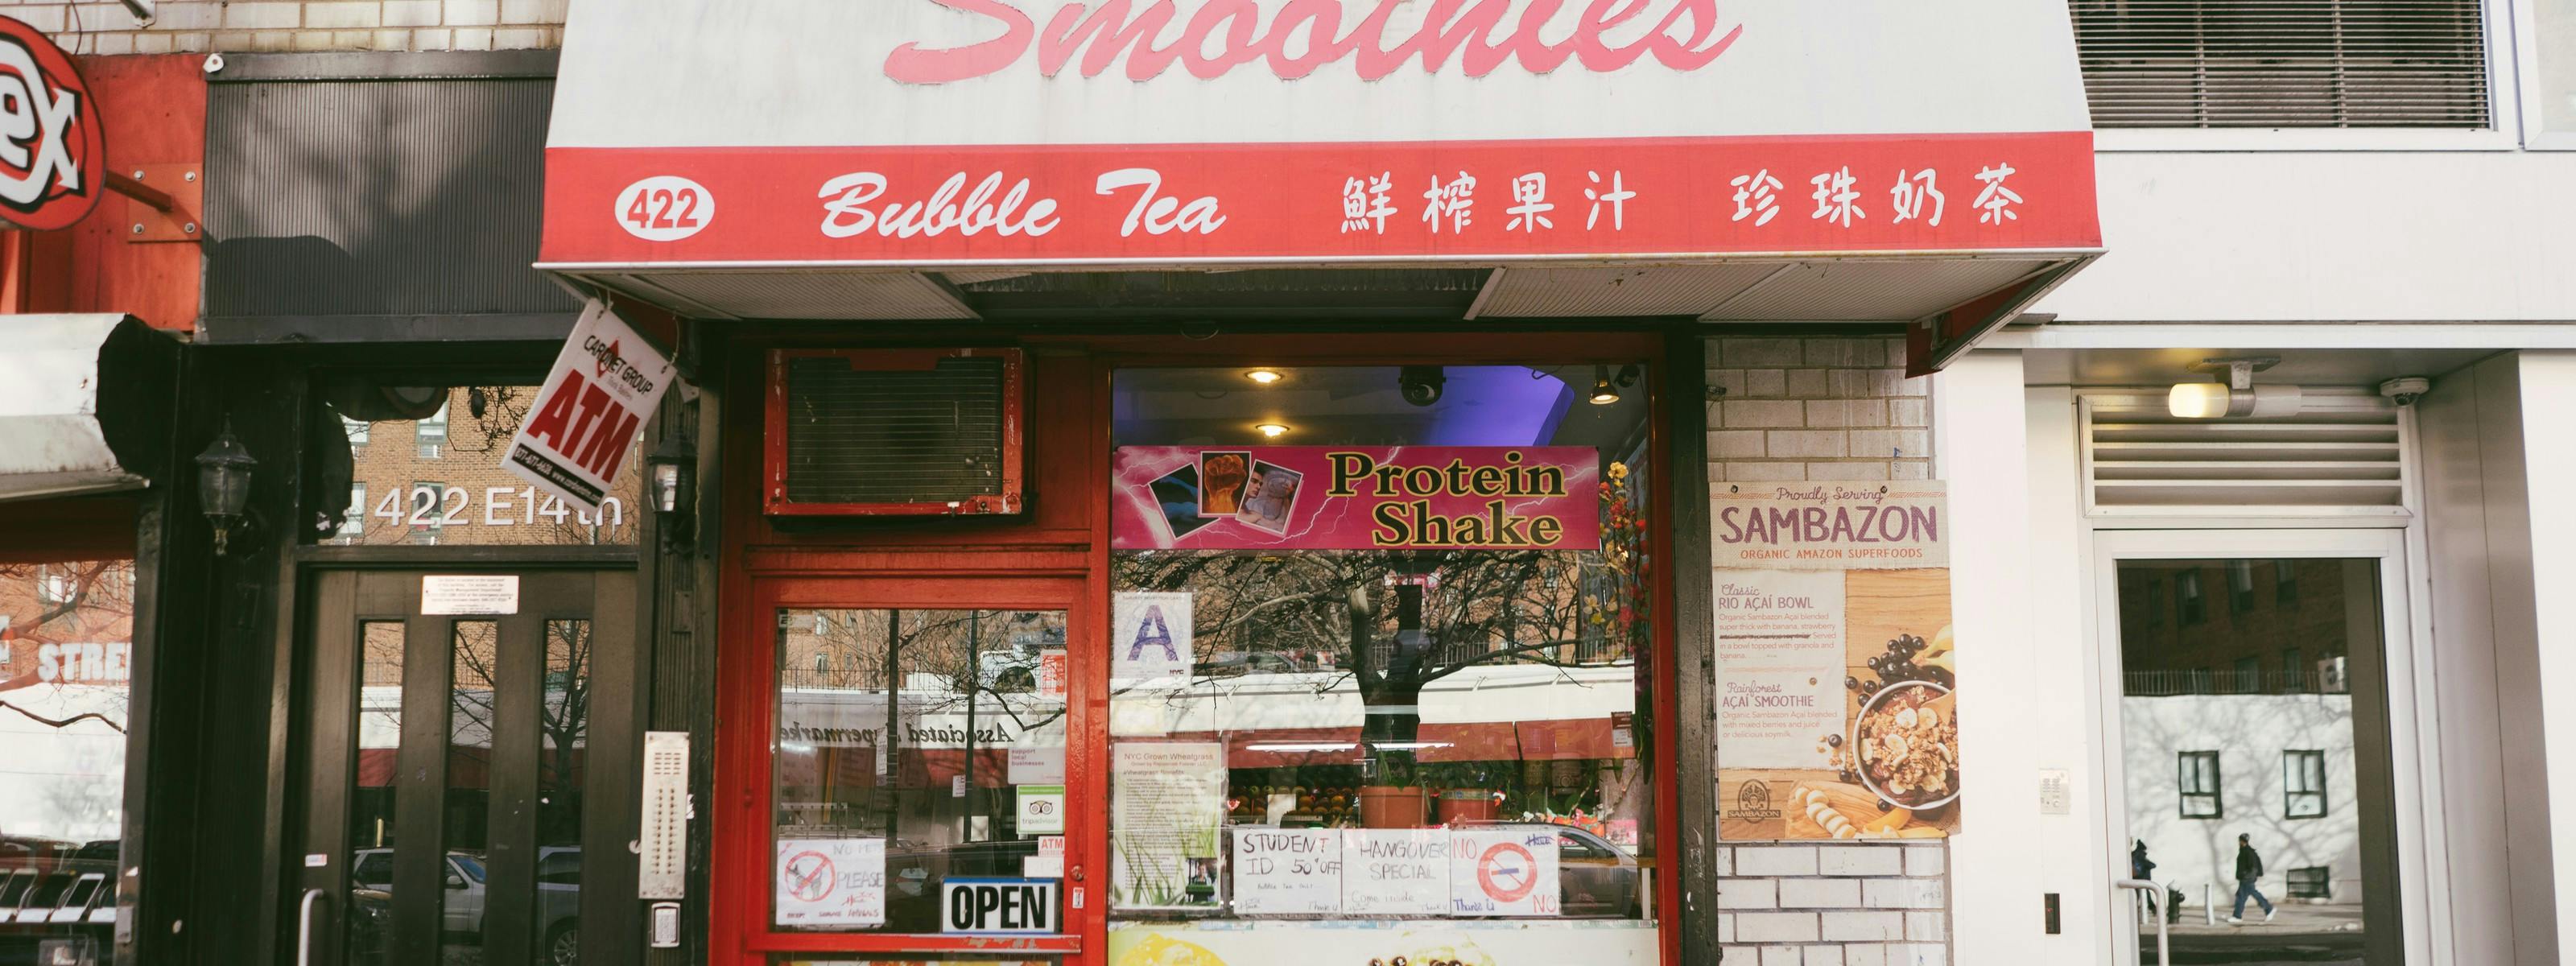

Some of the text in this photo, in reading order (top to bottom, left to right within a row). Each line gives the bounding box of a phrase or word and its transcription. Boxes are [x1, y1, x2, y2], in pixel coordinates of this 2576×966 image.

[818, 167, 1228, 238] Bubble Tea
[1340, 163, 2024, 234] 鮮榨果汁 珍珠奶茶
[625, 188, 700, 229] 422
[621, 364, 654, 395] GROUP
[526, 368, 641, 485] ATM
[1325, 451, 1567, 497] Protein
[1776, 486, 1884, 505] Proudly Serving
[374, 487, 470, 526] 422
[1371, 500, 1563, 547] Shake
[1719, 505, 1938, 545] SAMBAZON
[1740, 547, 1923, 560] ORGANIC AMAZON SUPERFOODS
[1721, 584, 1761, 596] Classic
[1719, 594, 1814, 612] RIO AÇAÍ BOWL
[1719, 613, 1745, 622] Organic
[1748, 613, 1782, 621] Sambazon
[1127, 605, 1179, 662] A
[1752, 642, 1777, 650] topped
[1794, 642, 1819, 650] granola
[38, 642, 132, 683] STRE
[1727, 680, 1782, 696] Rainforest
[1722, 694, 1814, 709] AÇAÍ SMOOTHIE
[1722, 711, 1751, 720] Organic
[1807, 710, 1837, 718] blended
[1802, 721, 1821, 729] juice
[1124, 753, 1141, 761] NYC
[1170, 753, 1214, 762] Wheatgrass
[1022, 818, 1058, 826] tripadvisor
[1041, 838, 1063, 849] ATM
[1243, 833, 1329, 853] STUDENT
[1360, 839, 1449, 860] HANGOVER
[1453, 837, 1477, 859] NO
[1245, 857, 1274, 876] ID
[1369, 862, 1436, 881] SPECIAL
[836, 872, 884, 889] PLEASE
[951, 886, 1046, 930] OPEN
[1533, 894, 1557, 914] NO
